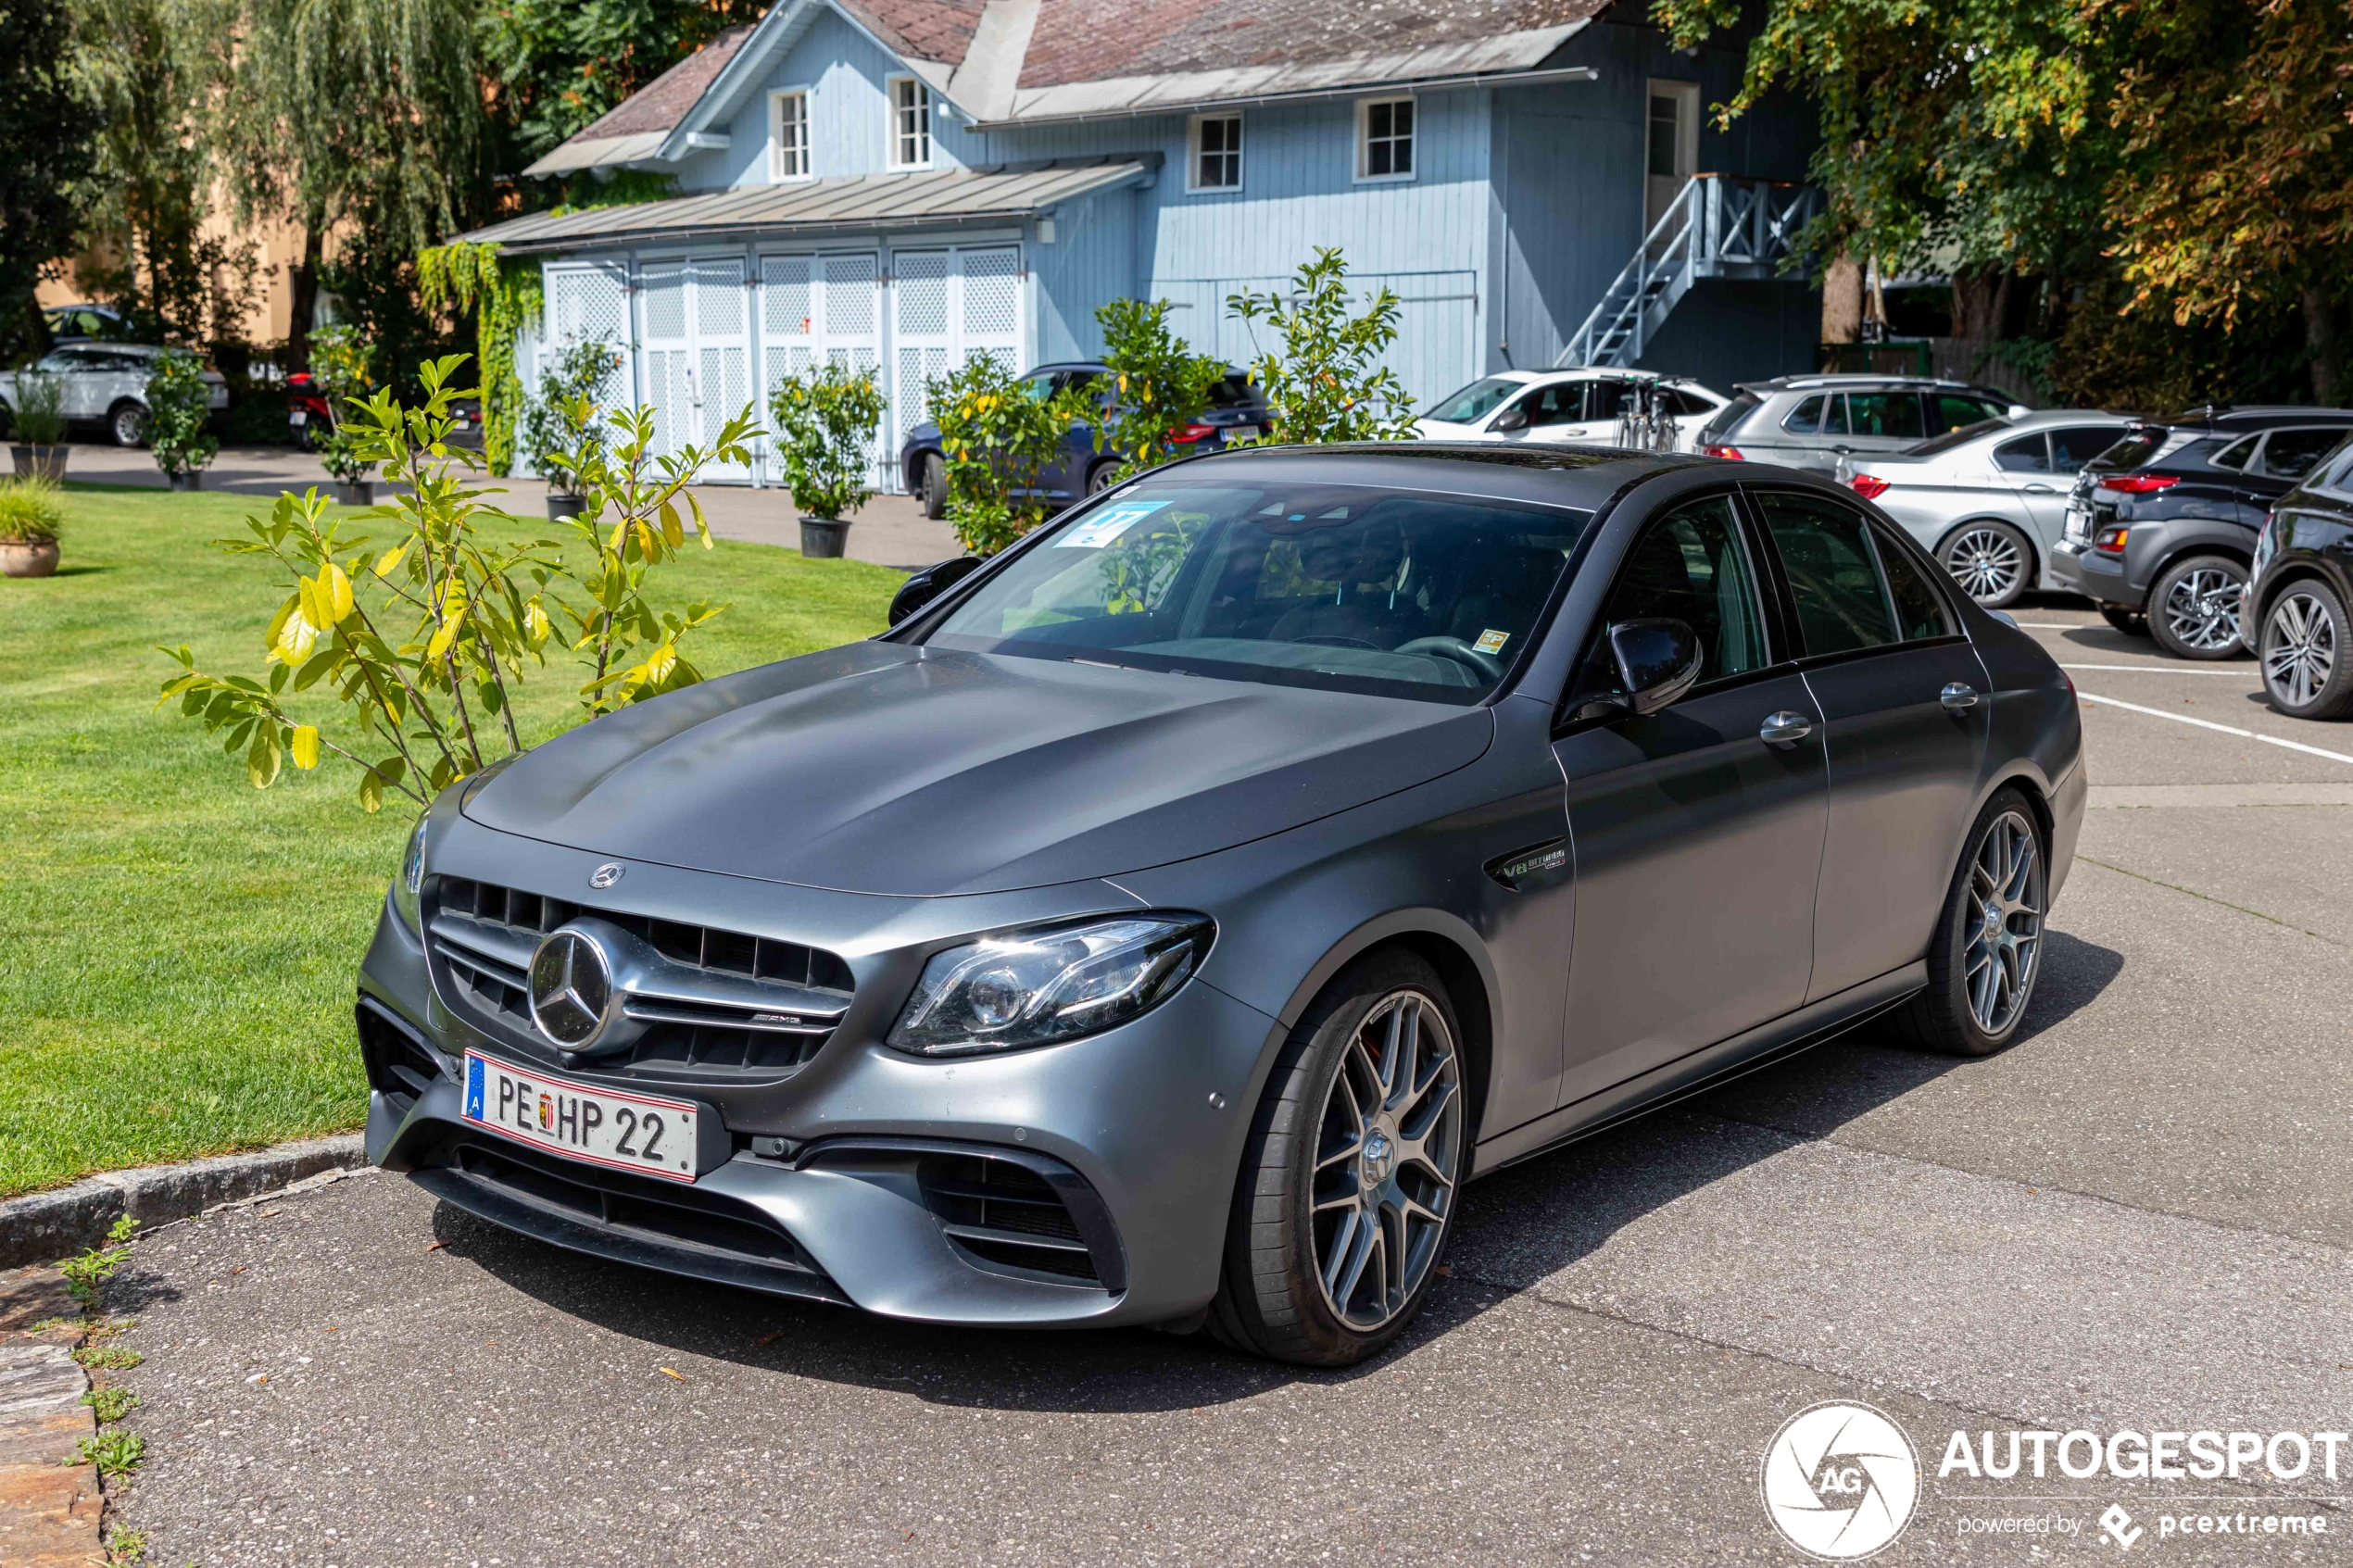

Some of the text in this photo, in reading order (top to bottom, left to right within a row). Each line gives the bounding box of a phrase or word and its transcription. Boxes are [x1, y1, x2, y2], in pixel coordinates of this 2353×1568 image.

[1504, 861, 1528, 878] V8
[1528, 849, 1565, 867] BITURBO
[769, 1015, 800, 1023] AMG
[472, 1074, 664, 1161] A PE HP 22
